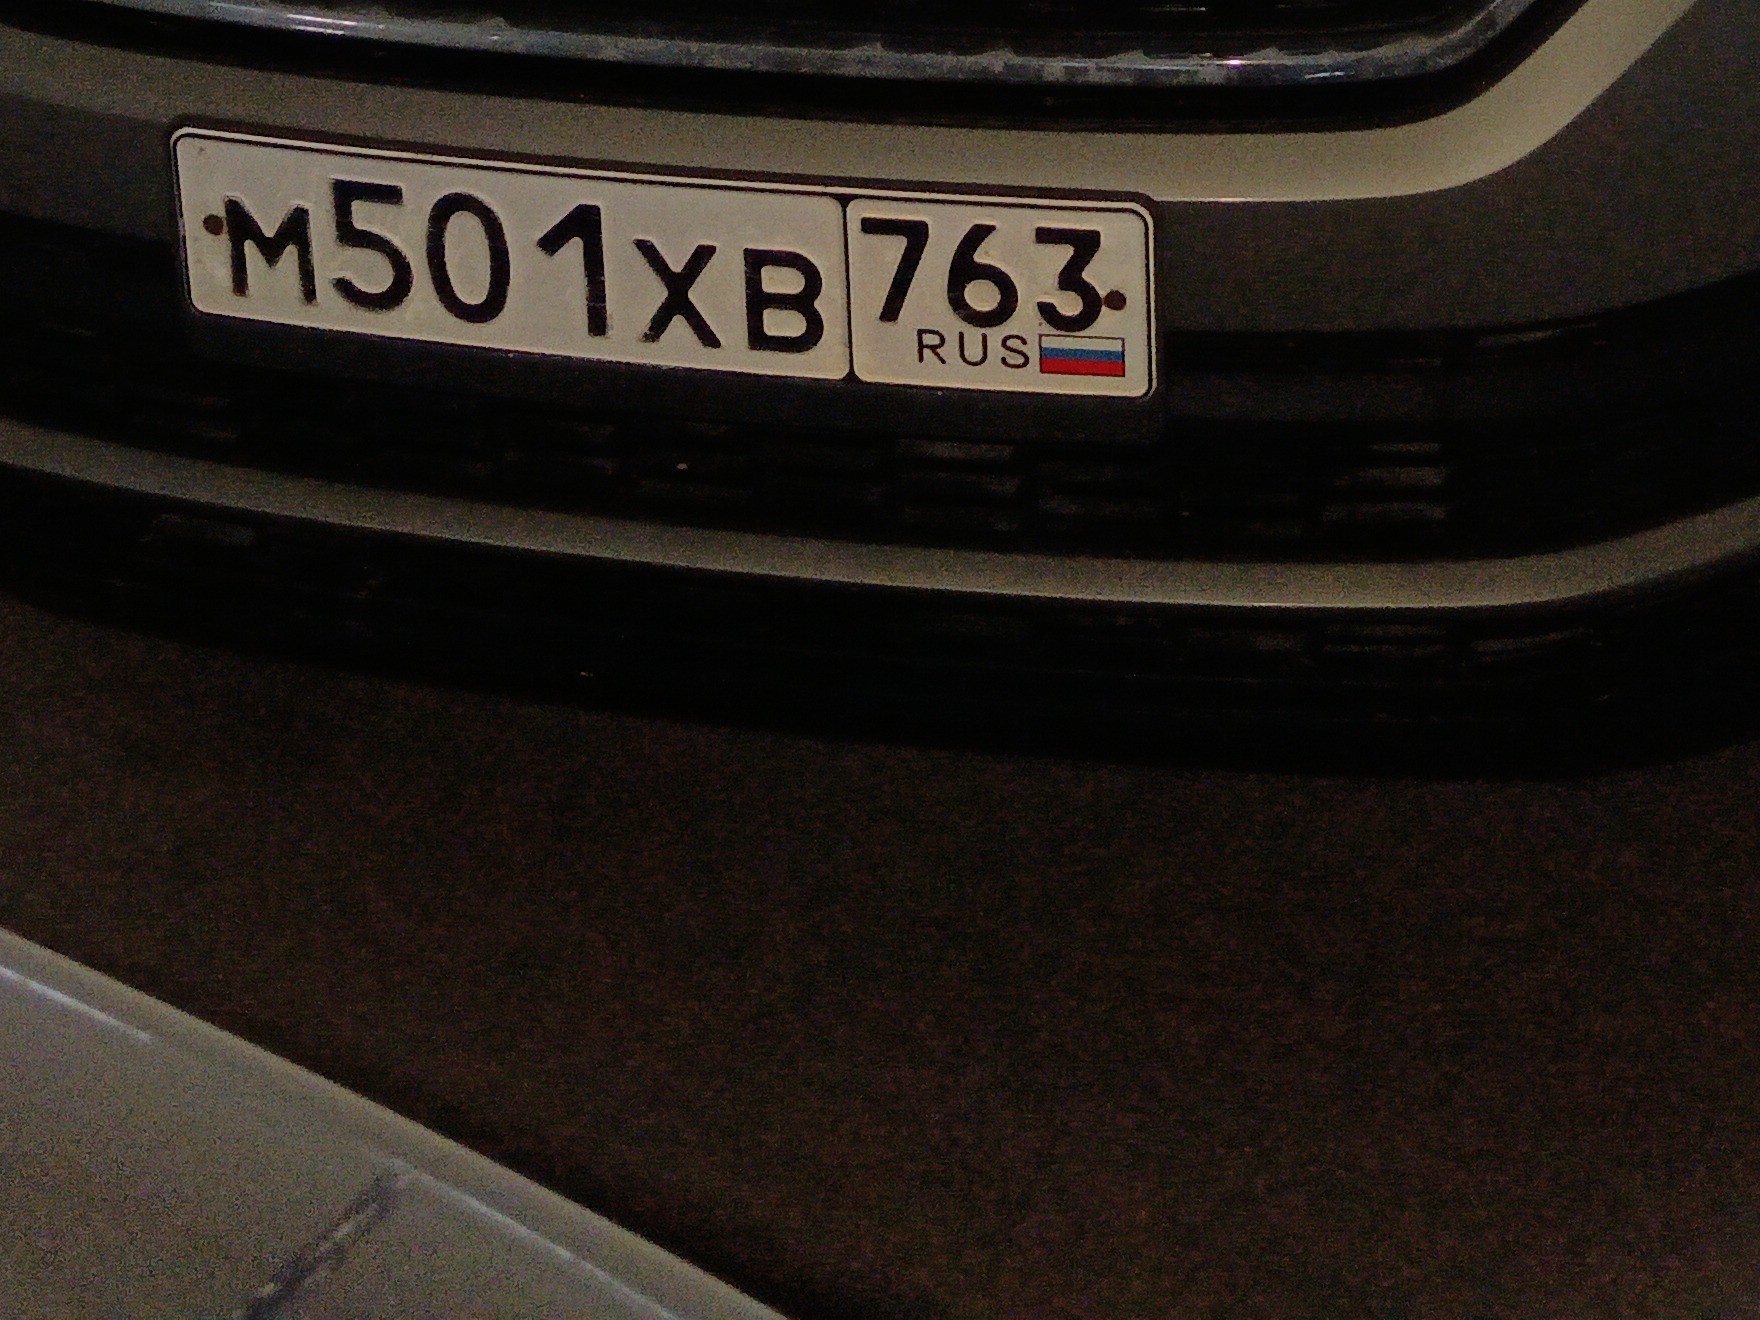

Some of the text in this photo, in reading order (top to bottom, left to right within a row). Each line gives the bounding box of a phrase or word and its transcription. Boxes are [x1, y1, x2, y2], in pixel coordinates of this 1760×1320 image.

[223, 176, 1104, 354] М501ХВ 763
[917, 329, 1031, 371] RUS
